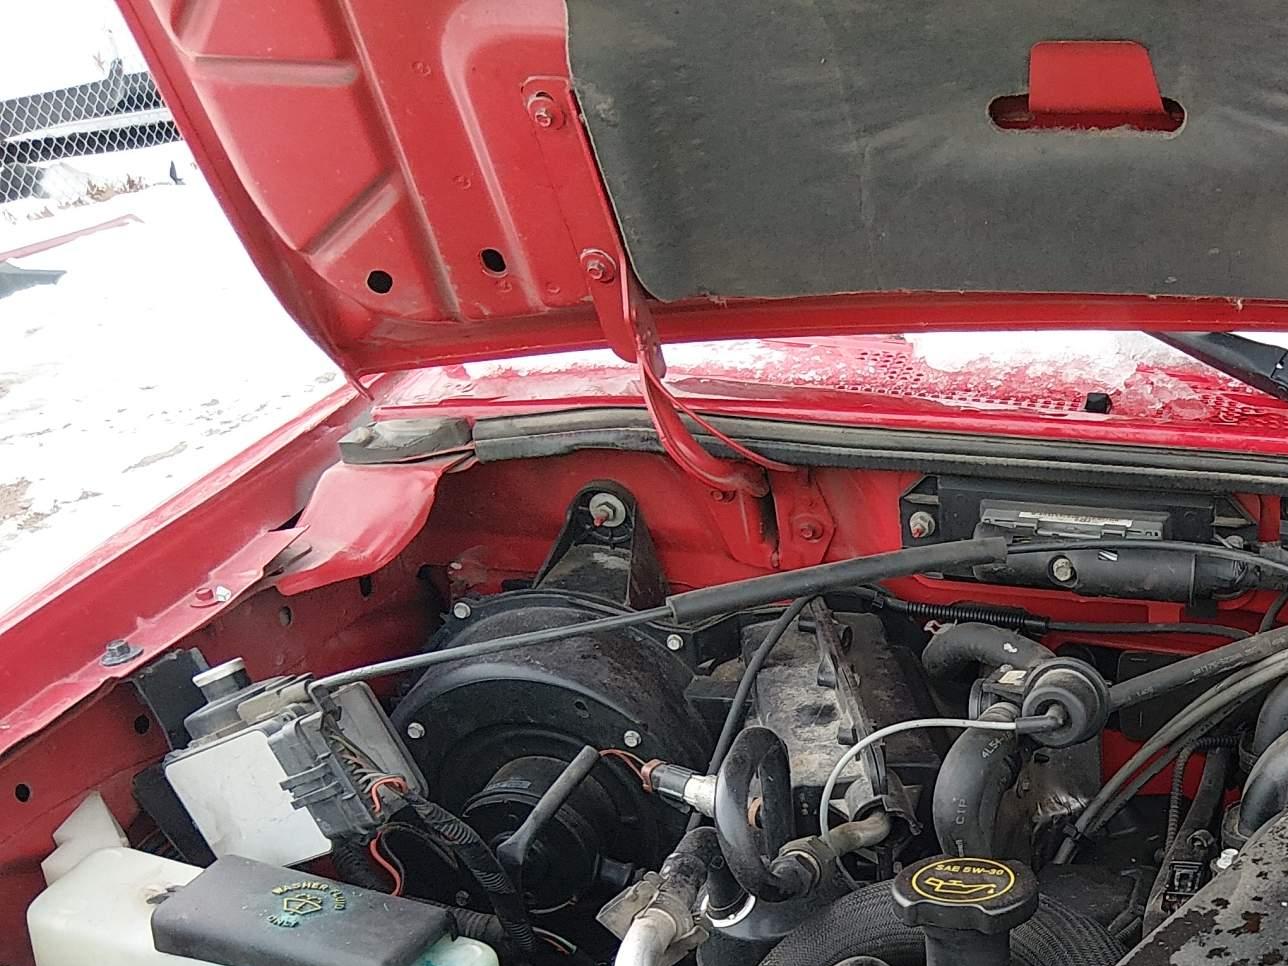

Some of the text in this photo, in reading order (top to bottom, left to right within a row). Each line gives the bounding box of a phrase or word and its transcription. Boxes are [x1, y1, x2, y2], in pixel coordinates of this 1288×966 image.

[935, 864, 1004, 876] SAE 5W-30
[272, 881, 329, 895] WASHER
[267, 915, 299, 927] ONLY
